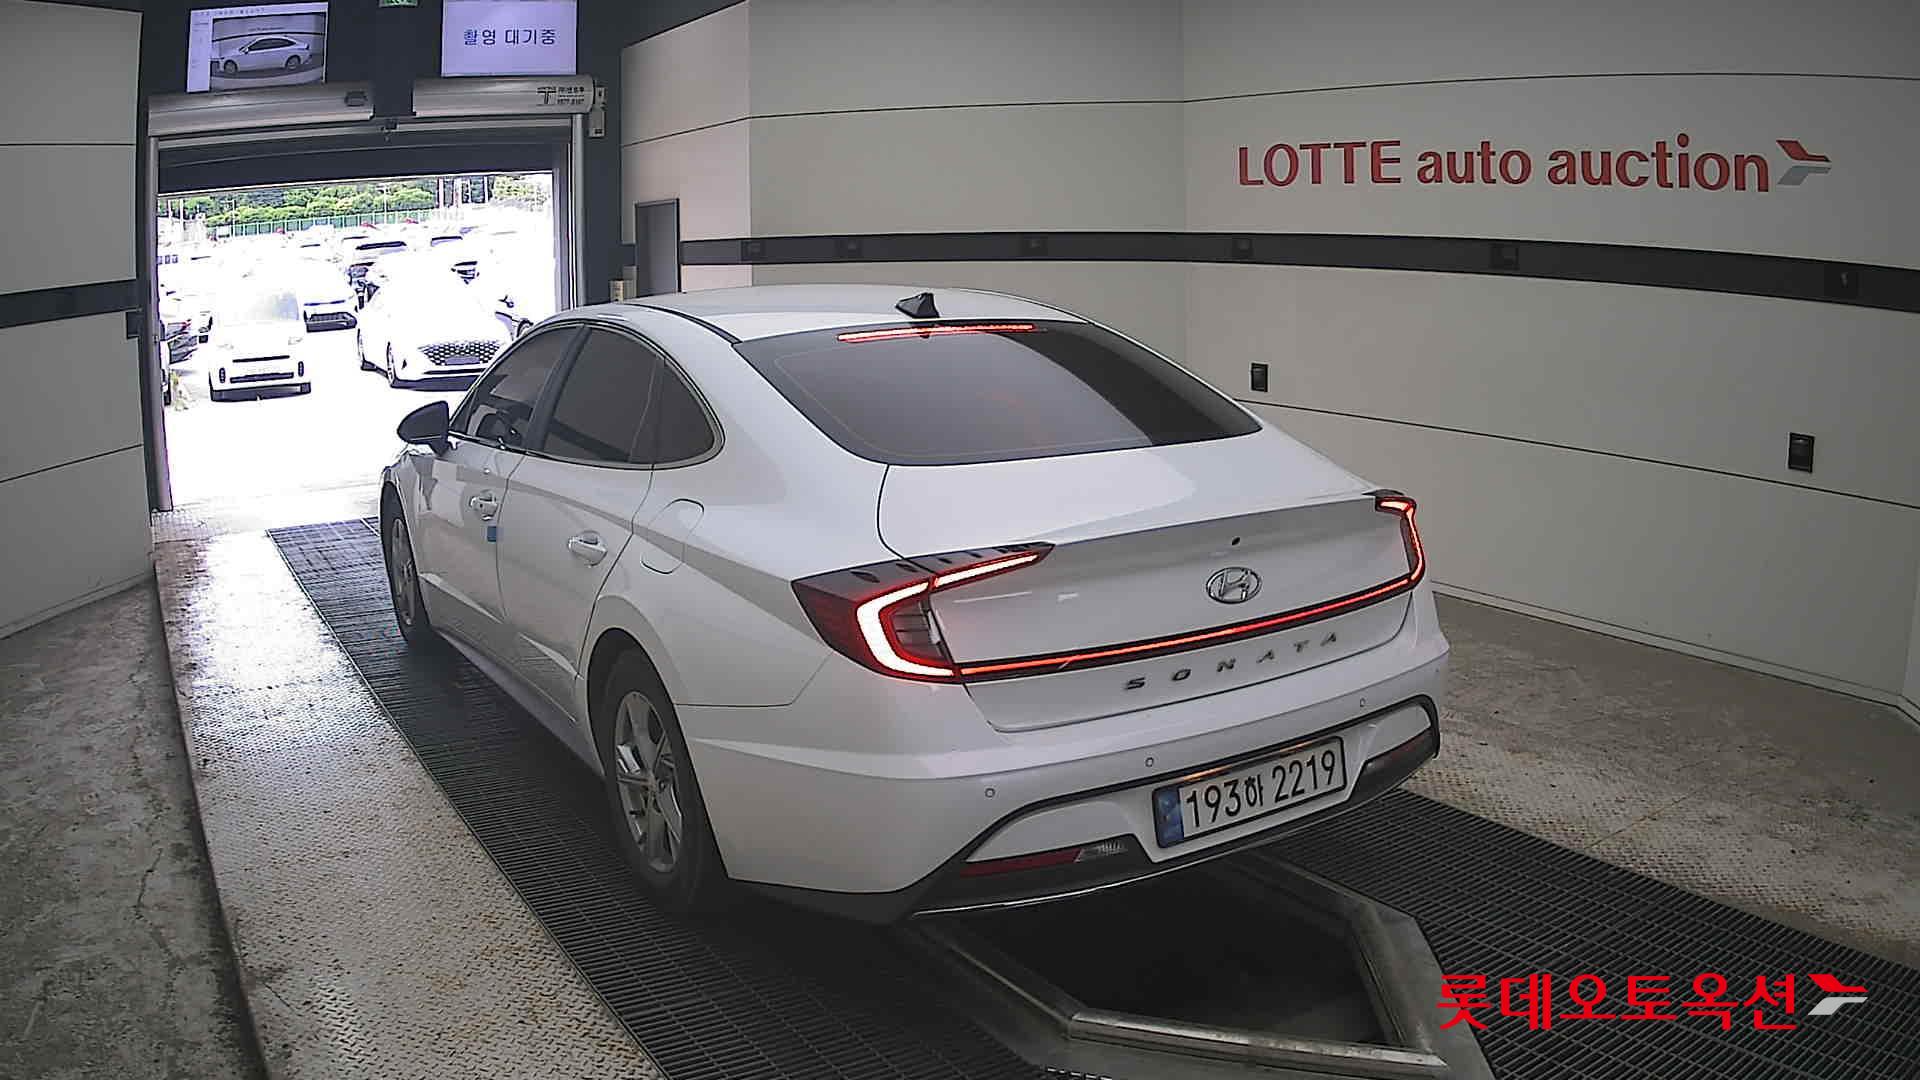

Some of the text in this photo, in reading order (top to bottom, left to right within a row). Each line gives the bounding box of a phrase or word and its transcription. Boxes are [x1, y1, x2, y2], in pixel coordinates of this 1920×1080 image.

[505, 29, 556, 45] 대기중
[1238, 134, 1770, 192] LOTTE auto auction
[1125, 632, 1338, 690] SONATA
[1186, 750, 1336, 828] 193하 2219
